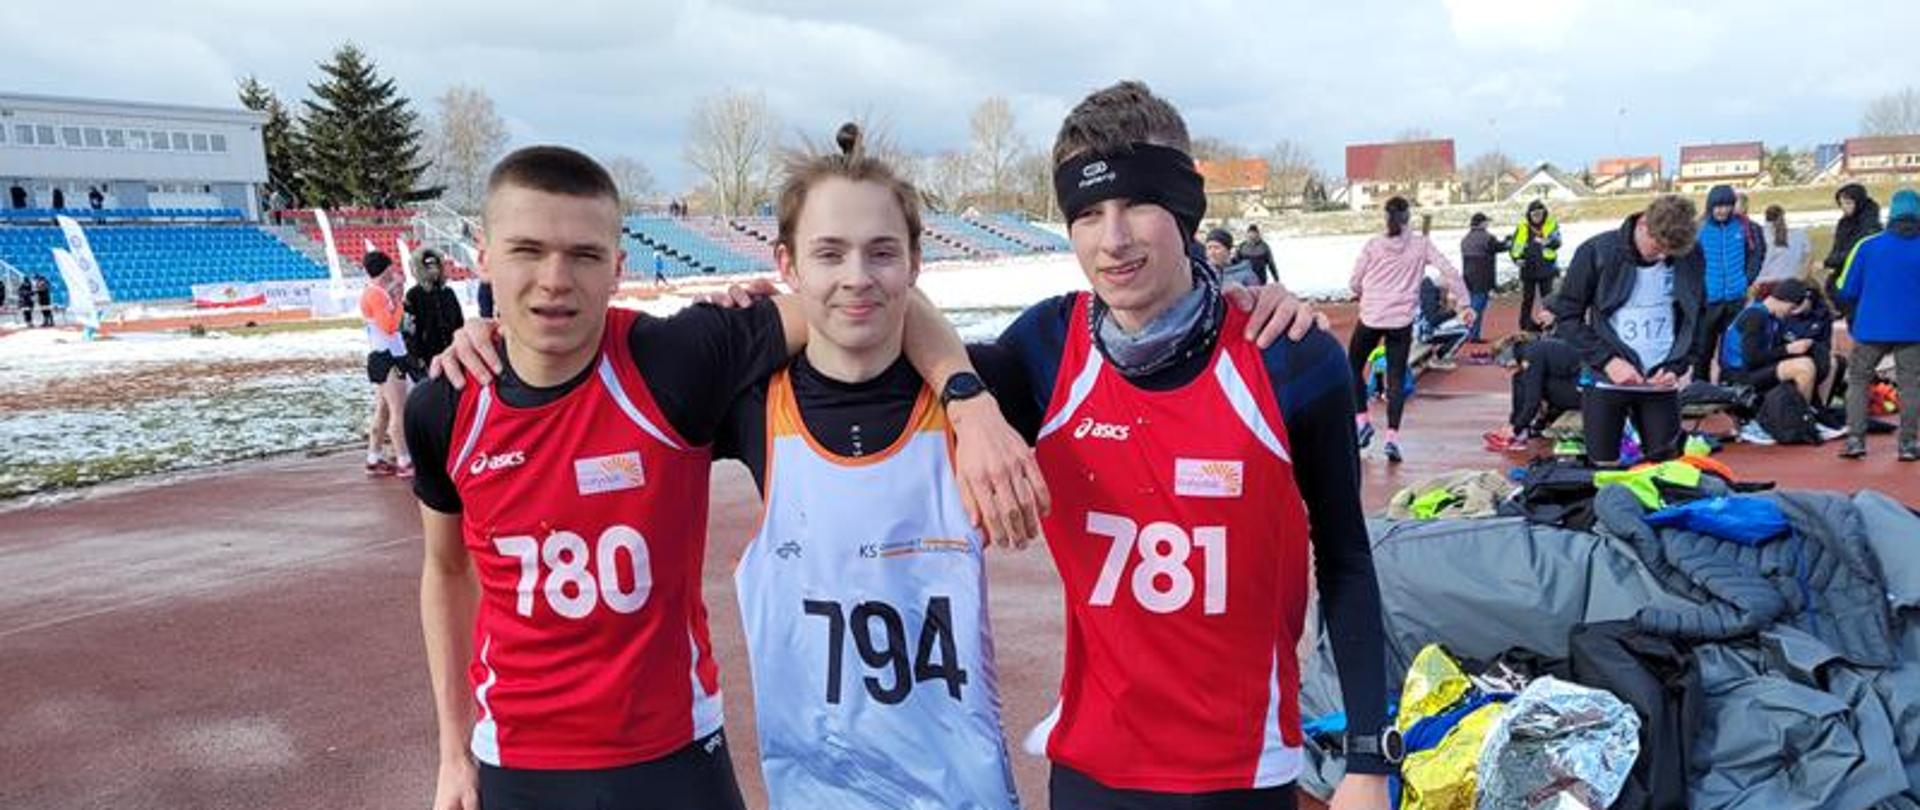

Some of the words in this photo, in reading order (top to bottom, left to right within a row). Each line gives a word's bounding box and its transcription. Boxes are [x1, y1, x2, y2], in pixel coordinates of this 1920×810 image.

[1623, 317, 1666, 341] 317
[493, 525, 652, 619] 780
[1085, 511, 1227, 614] 781
[803, 596, 968, 705] 794
